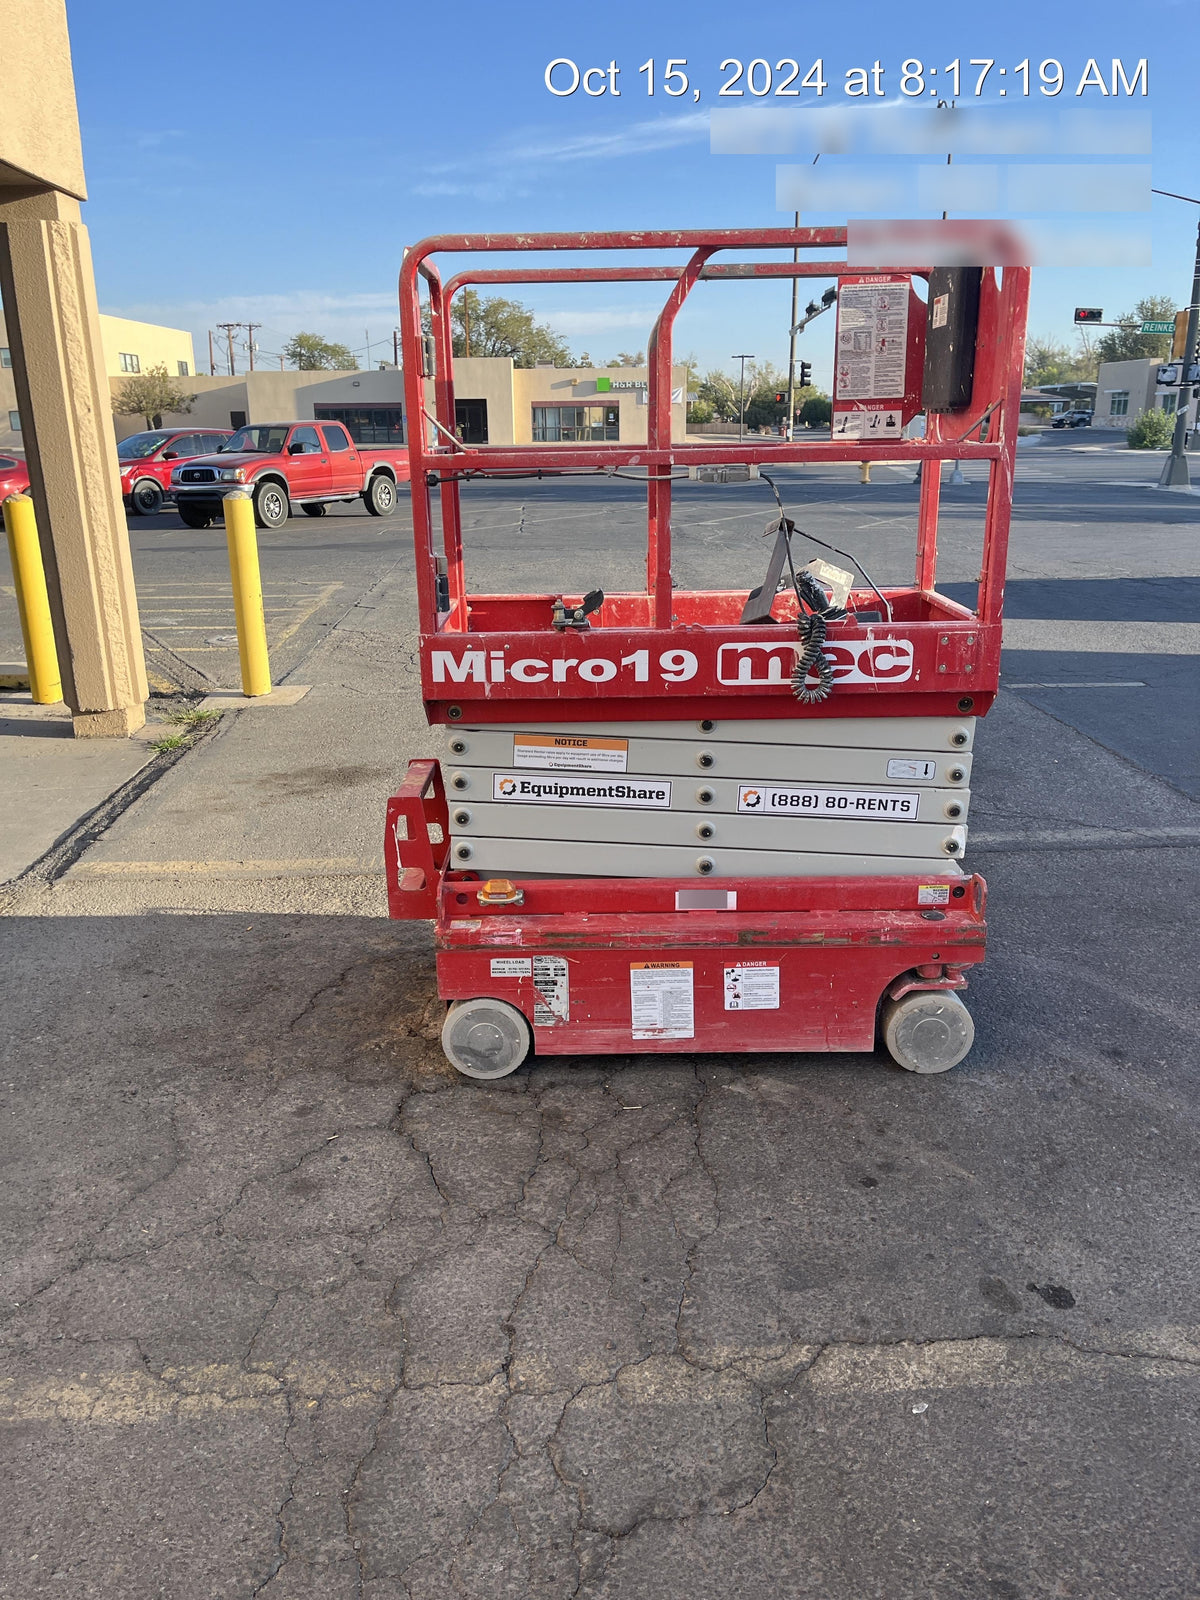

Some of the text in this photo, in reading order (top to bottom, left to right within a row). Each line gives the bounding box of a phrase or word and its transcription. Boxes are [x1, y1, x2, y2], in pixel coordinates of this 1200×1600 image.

[865, 275, 892, 283] DANGER
[1144, 323, 1175, 332] REINKE
[612, 381, 632, 389] H&R
[431, 645, 911, 683] Micro19 mec
[554, 738, 588, 747] NOTICE
[519, 781, 666, 800] EquipmentShare
[771, 793, 911, 812] (888) 80-RENTS
